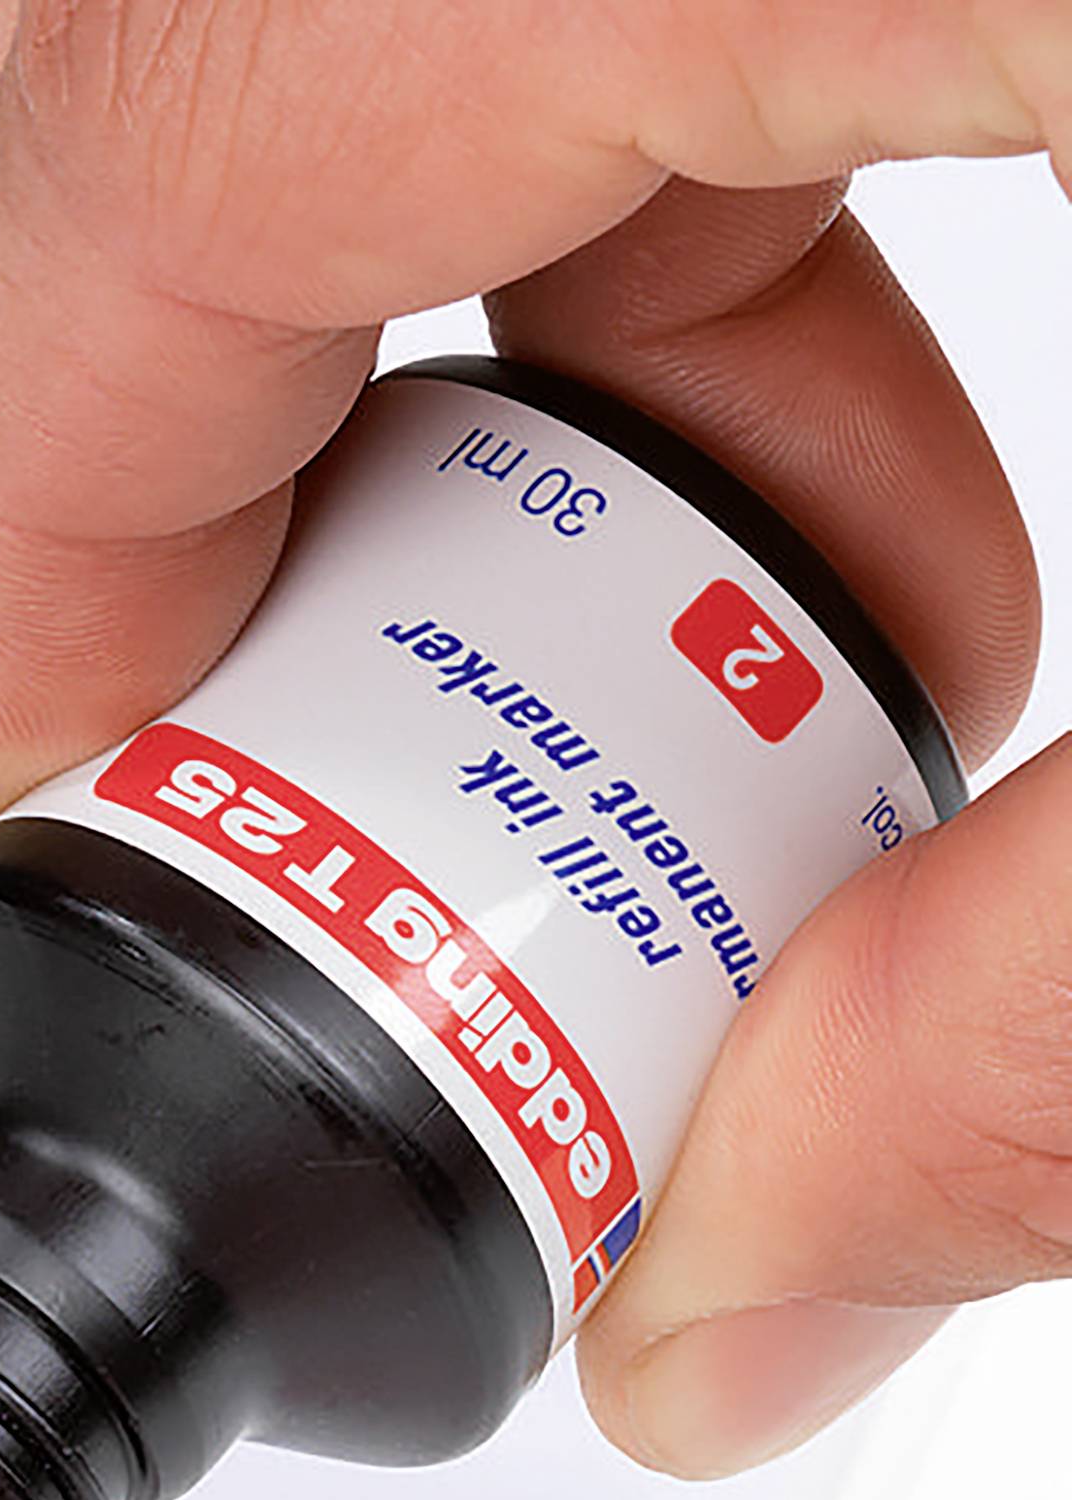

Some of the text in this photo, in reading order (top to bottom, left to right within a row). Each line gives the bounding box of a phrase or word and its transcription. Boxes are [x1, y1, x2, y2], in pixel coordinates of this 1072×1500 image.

[436, 428, 607, 537] 30 ml
[721, 623, 786, 691] 2
[381, 619, 757, 1000] rmanent marker
[458, 750, 683, 968] refill ink
[861, 785, 903, 851] col.
[154, 758, 613, 1200] edding T 25
